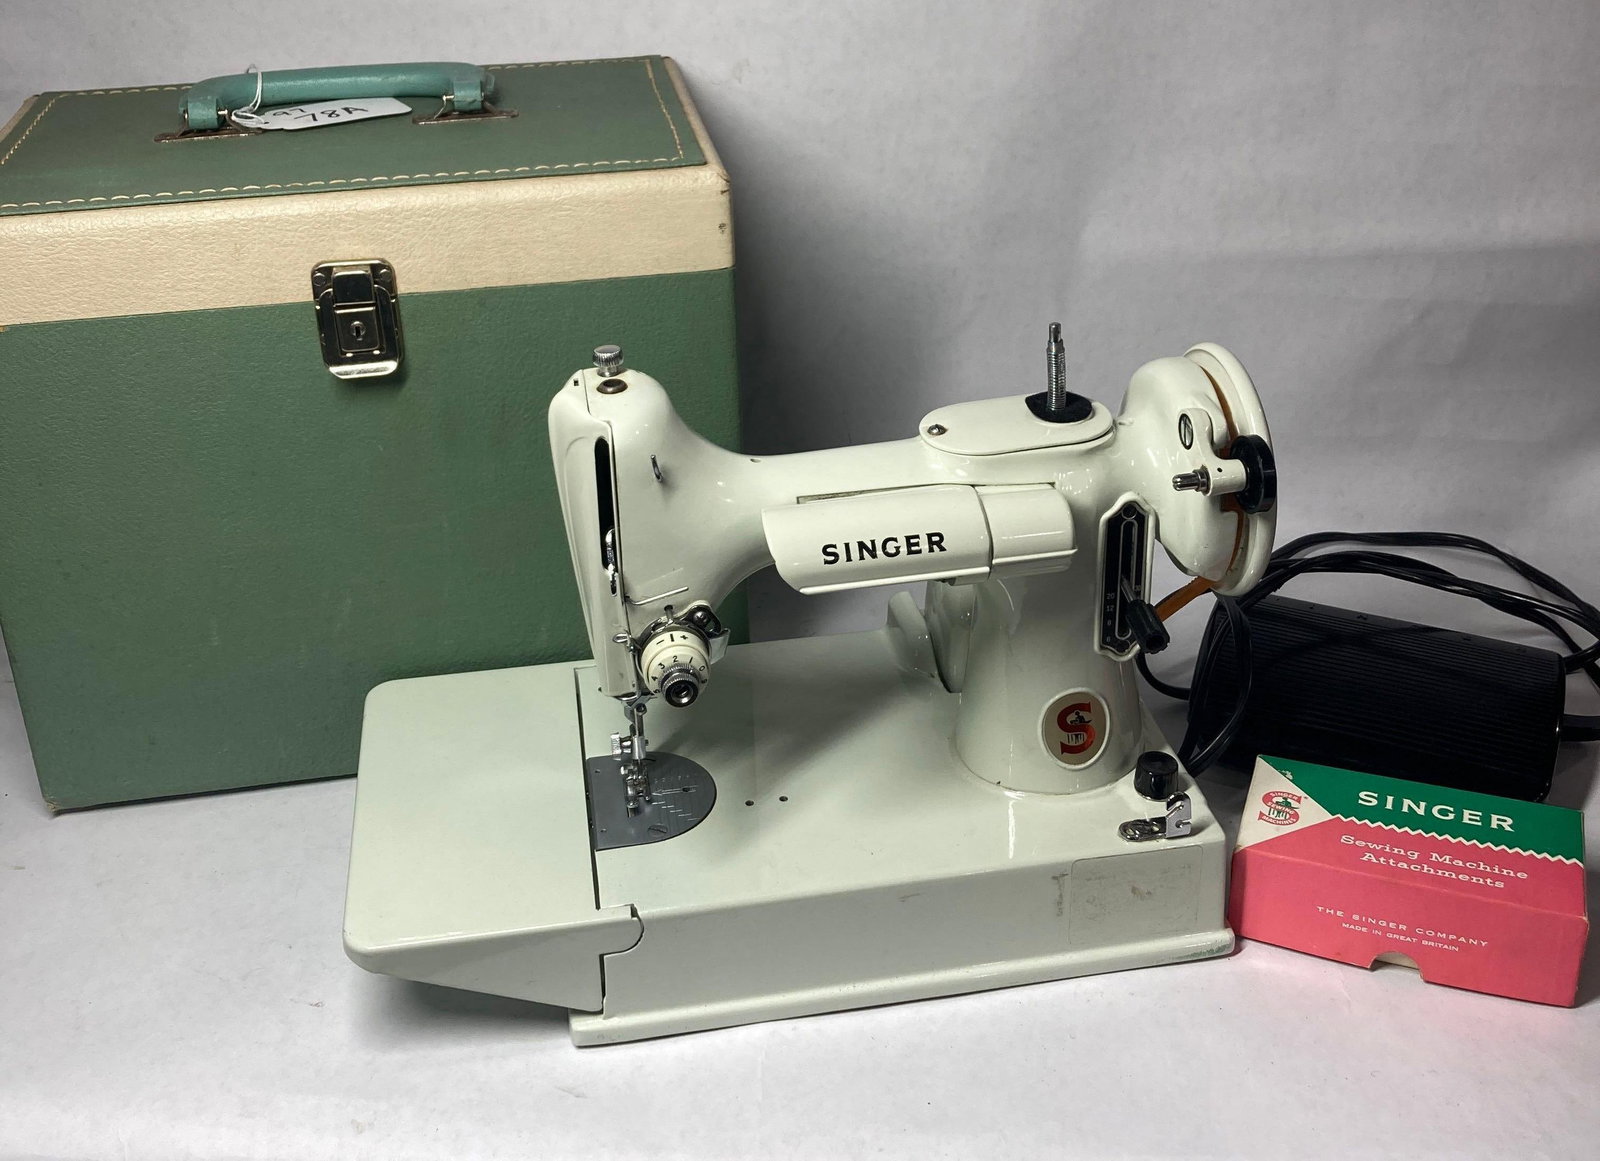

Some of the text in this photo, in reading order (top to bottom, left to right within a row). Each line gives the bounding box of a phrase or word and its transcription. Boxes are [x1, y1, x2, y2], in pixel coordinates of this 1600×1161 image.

[294, 106, 368, 122] 78A
[821, 531, 947, 565] SINGER
[657, 662, 666, 670] 3
[672, 655, 679, 663] 2
[1267, 801, 1296, 815] SEWING
[1269, 791, 1299, 801] SINGER
[1358, 790, 1515, 832] SINGER
[1340, 834, 1528, 879] Sewing Machine
[1360, 852, 1504, 888] Attachments
[1316, 905, 1489, 947] THE SINGER COMPANY
[1341, 922, 1368, 933] MADE
[1386, 932, 1418, 943] GREAT
[1421, 939, 1459, 952] BRITAIN
